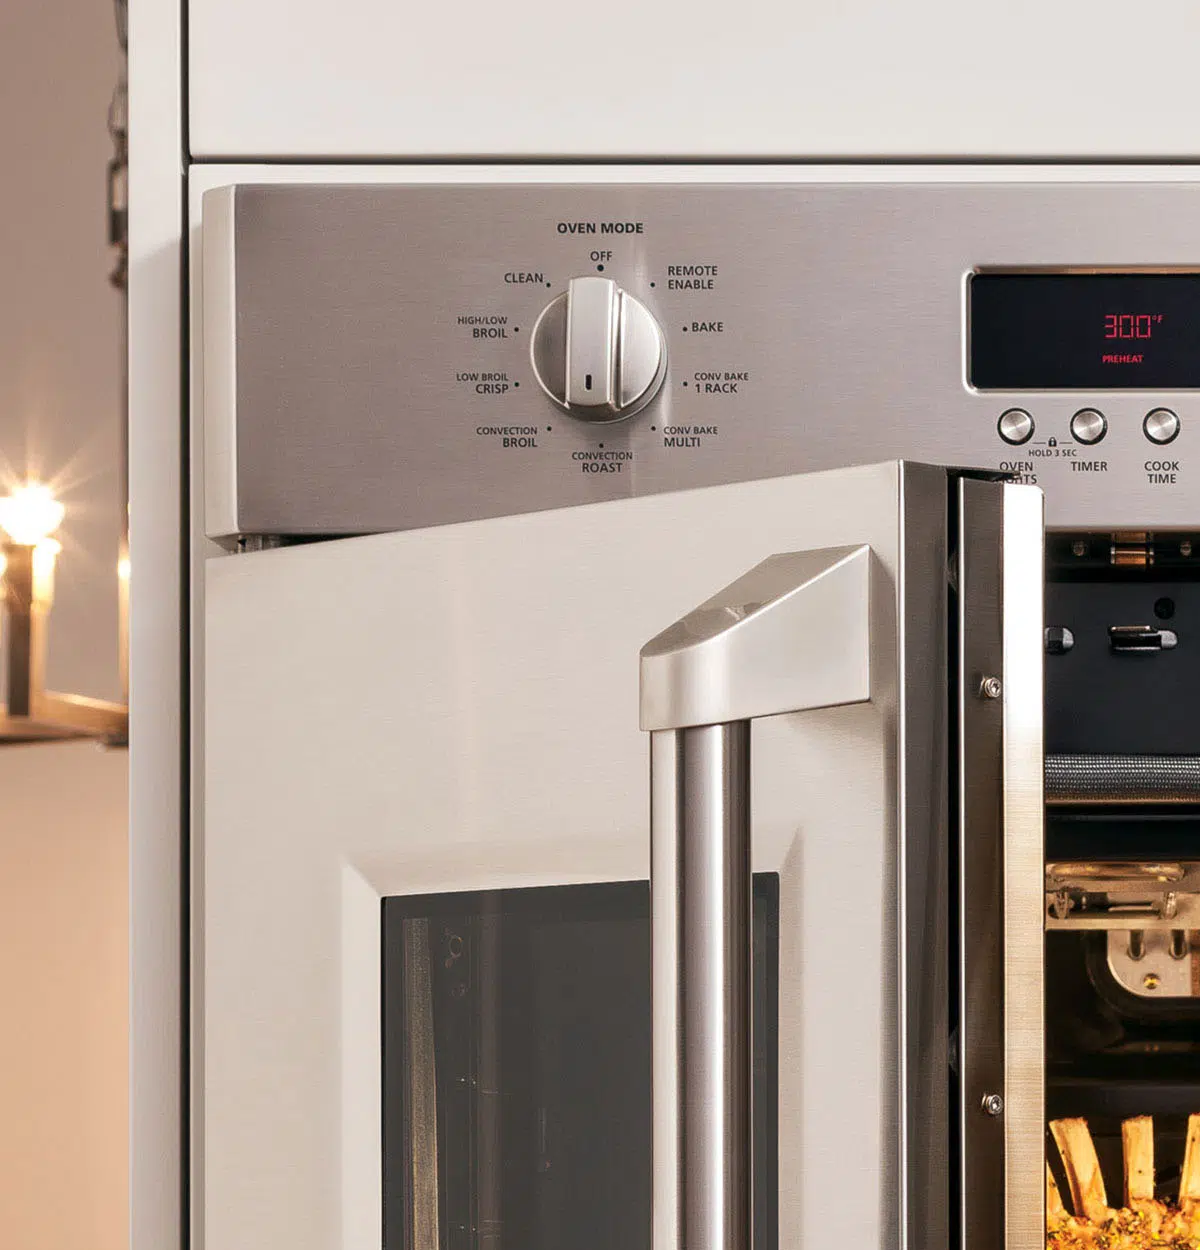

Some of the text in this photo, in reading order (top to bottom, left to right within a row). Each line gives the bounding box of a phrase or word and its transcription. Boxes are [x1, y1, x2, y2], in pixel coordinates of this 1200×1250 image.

[556, 222, 644, 234] OVEN MODE
[589, 250, 613, 262] OFF
[667, 265, 718, 277] REMOTE
[504, 272, 544, 284] CLEAN
[667, 279, 714, 290] ENABLE
[457, 315, 508, 325] HIGH/LOW
[691, 321, 724, 333] BAKE
[472, 327, 509, 339] BROIL
[1102, 355, 1144, 364] PREHEAT
[456, 372, 509, 382] LOW BROIL
[694, 372, 749, 382] CONV BAKE
[475, 383, 509, 395] CRISP
[695, 382, 738, 394] 1 RACK
[476, 426, 538, 436] CONVECTION
[663, 425, 718, 436] CONV BAKE
[502, 437, 538, 448] BROIL
[663, 436, 701, 448] MULTI
[571, 450, 633, 461] CONVECTION
[1028, 448, 1078, 458] HOLD 3 SEC
[581, 462, 623, 474] ROAST
[999, 460, 1034, 472] OVEN
[1070, 461, 1108, 472] TIMER
[1144, 460, 1180, 472] COOK
[1147, 473, 1177, 484] TIME
